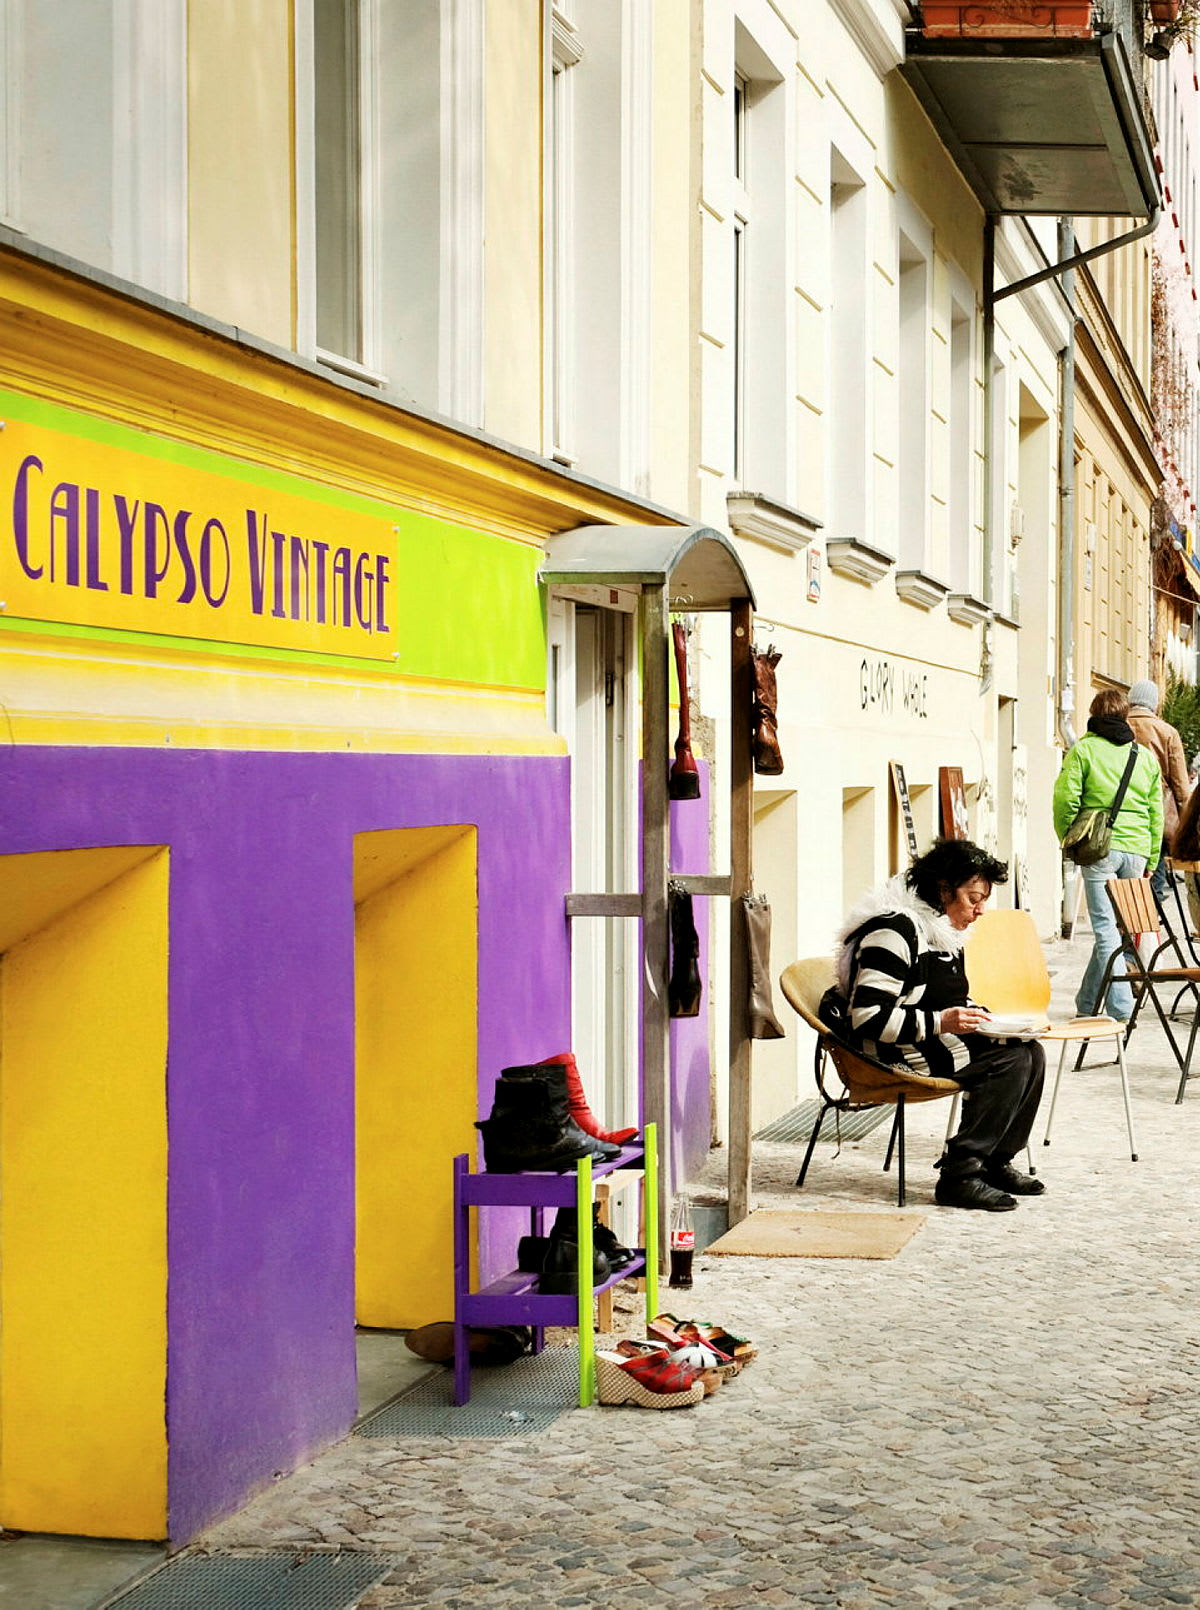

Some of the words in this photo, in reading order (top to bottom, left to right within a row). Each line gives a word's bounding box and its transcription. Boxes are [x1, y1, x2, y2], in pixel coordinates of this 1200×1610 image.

[12, 454, 231, 609] CALYPSO
[246, 509, 391, 635] VINTAGE
[859, 657, 895, 715] GLORY
